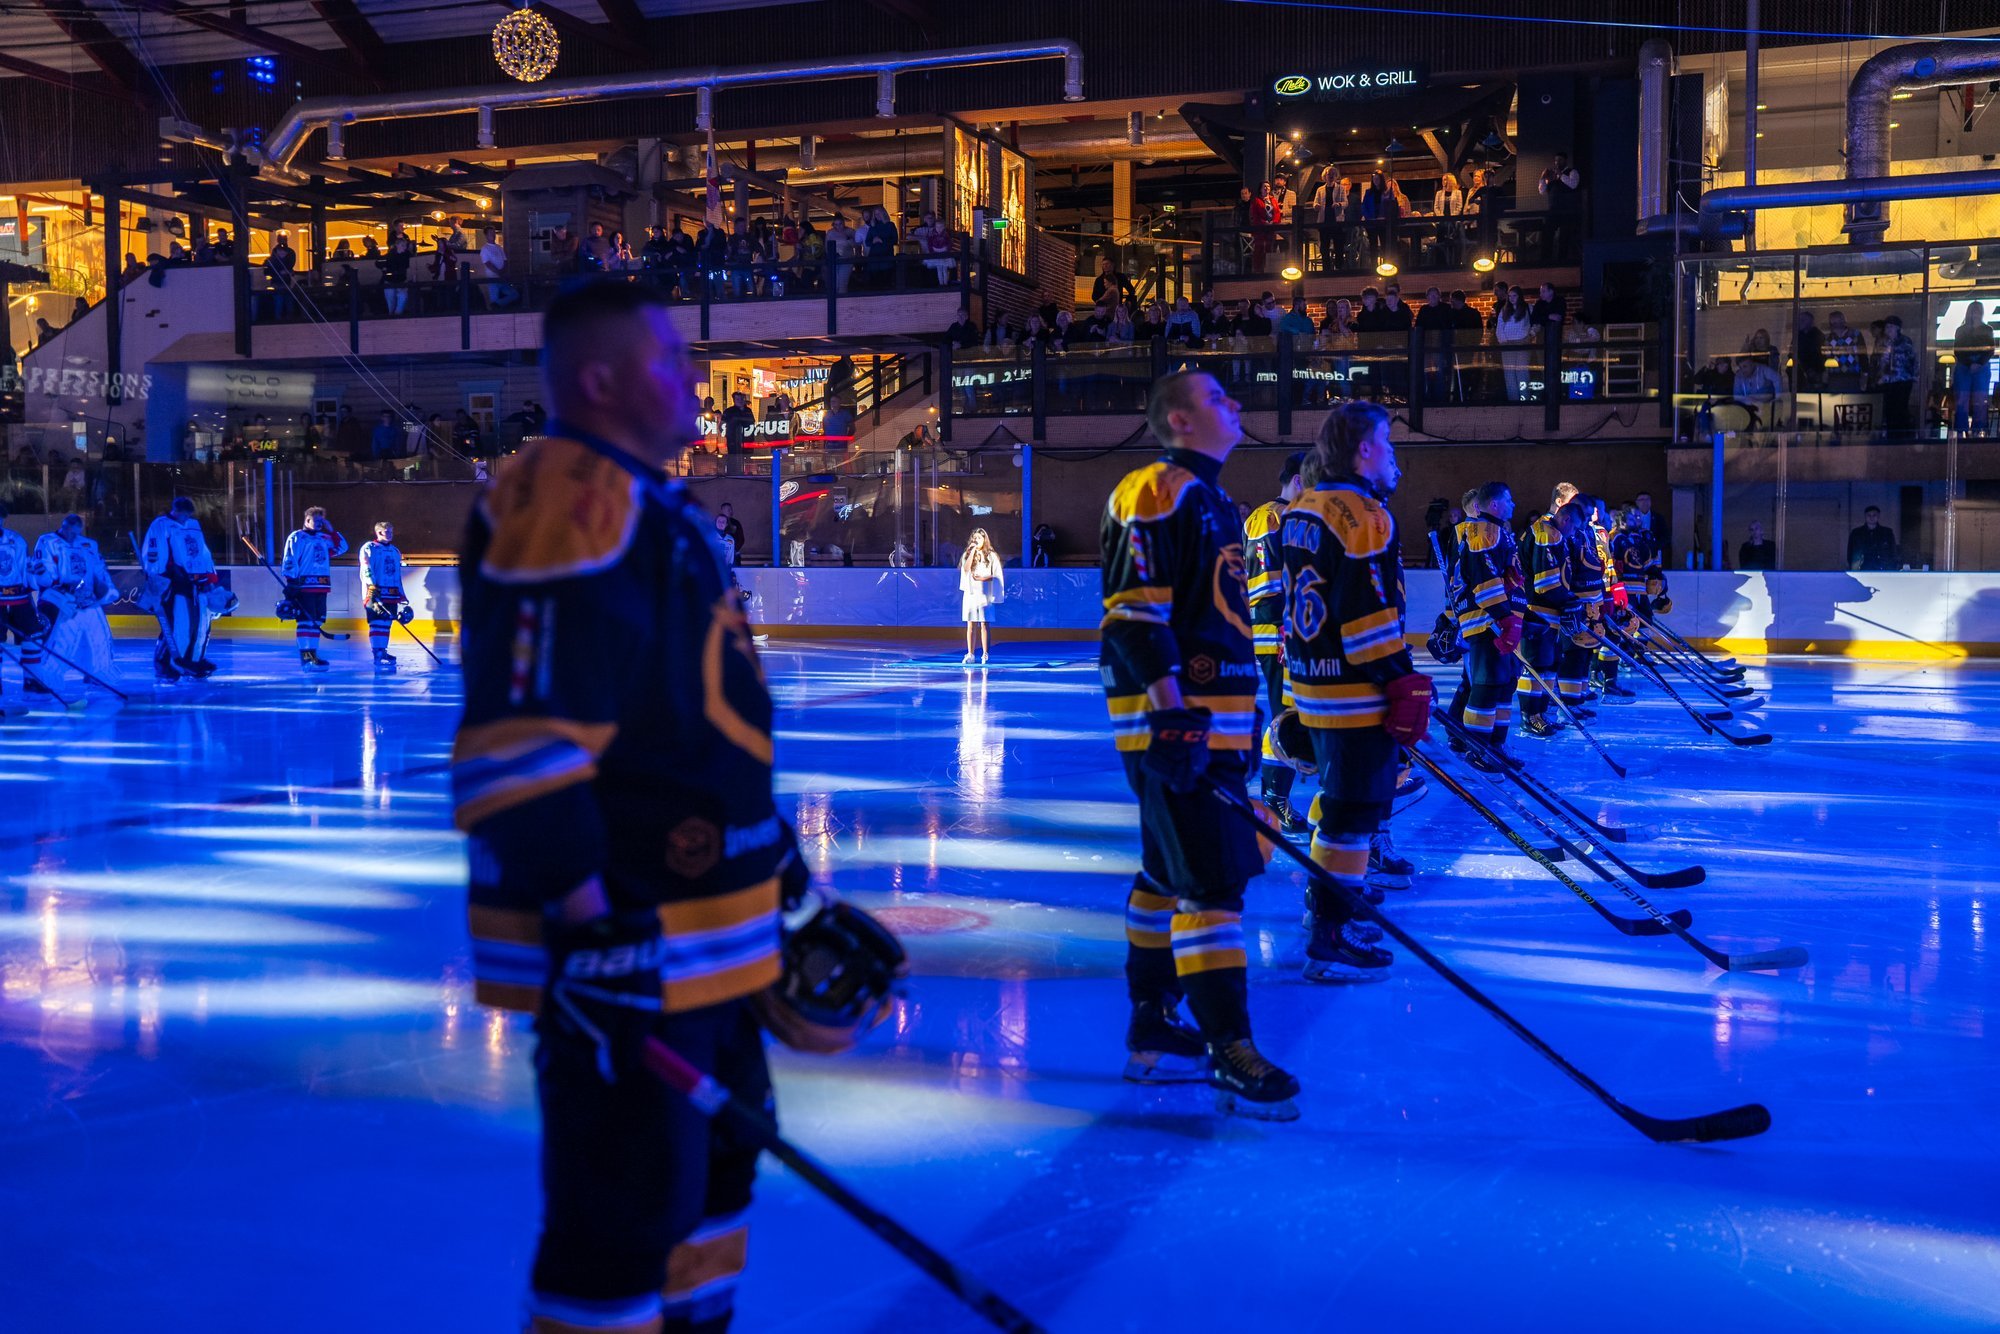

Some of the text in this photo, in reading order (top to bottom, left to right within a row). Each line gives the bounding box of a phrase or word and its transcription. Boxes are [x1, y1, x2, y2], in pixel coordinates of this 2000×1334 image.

[1318, 75, 1355, 90] WOK
[1359, 74, 1371, 87] &
[1376, 70, 1416, 86] GRILL
[225, 374, 280, 385] YOLO
[1310, 658, 1341, 677] Mill
